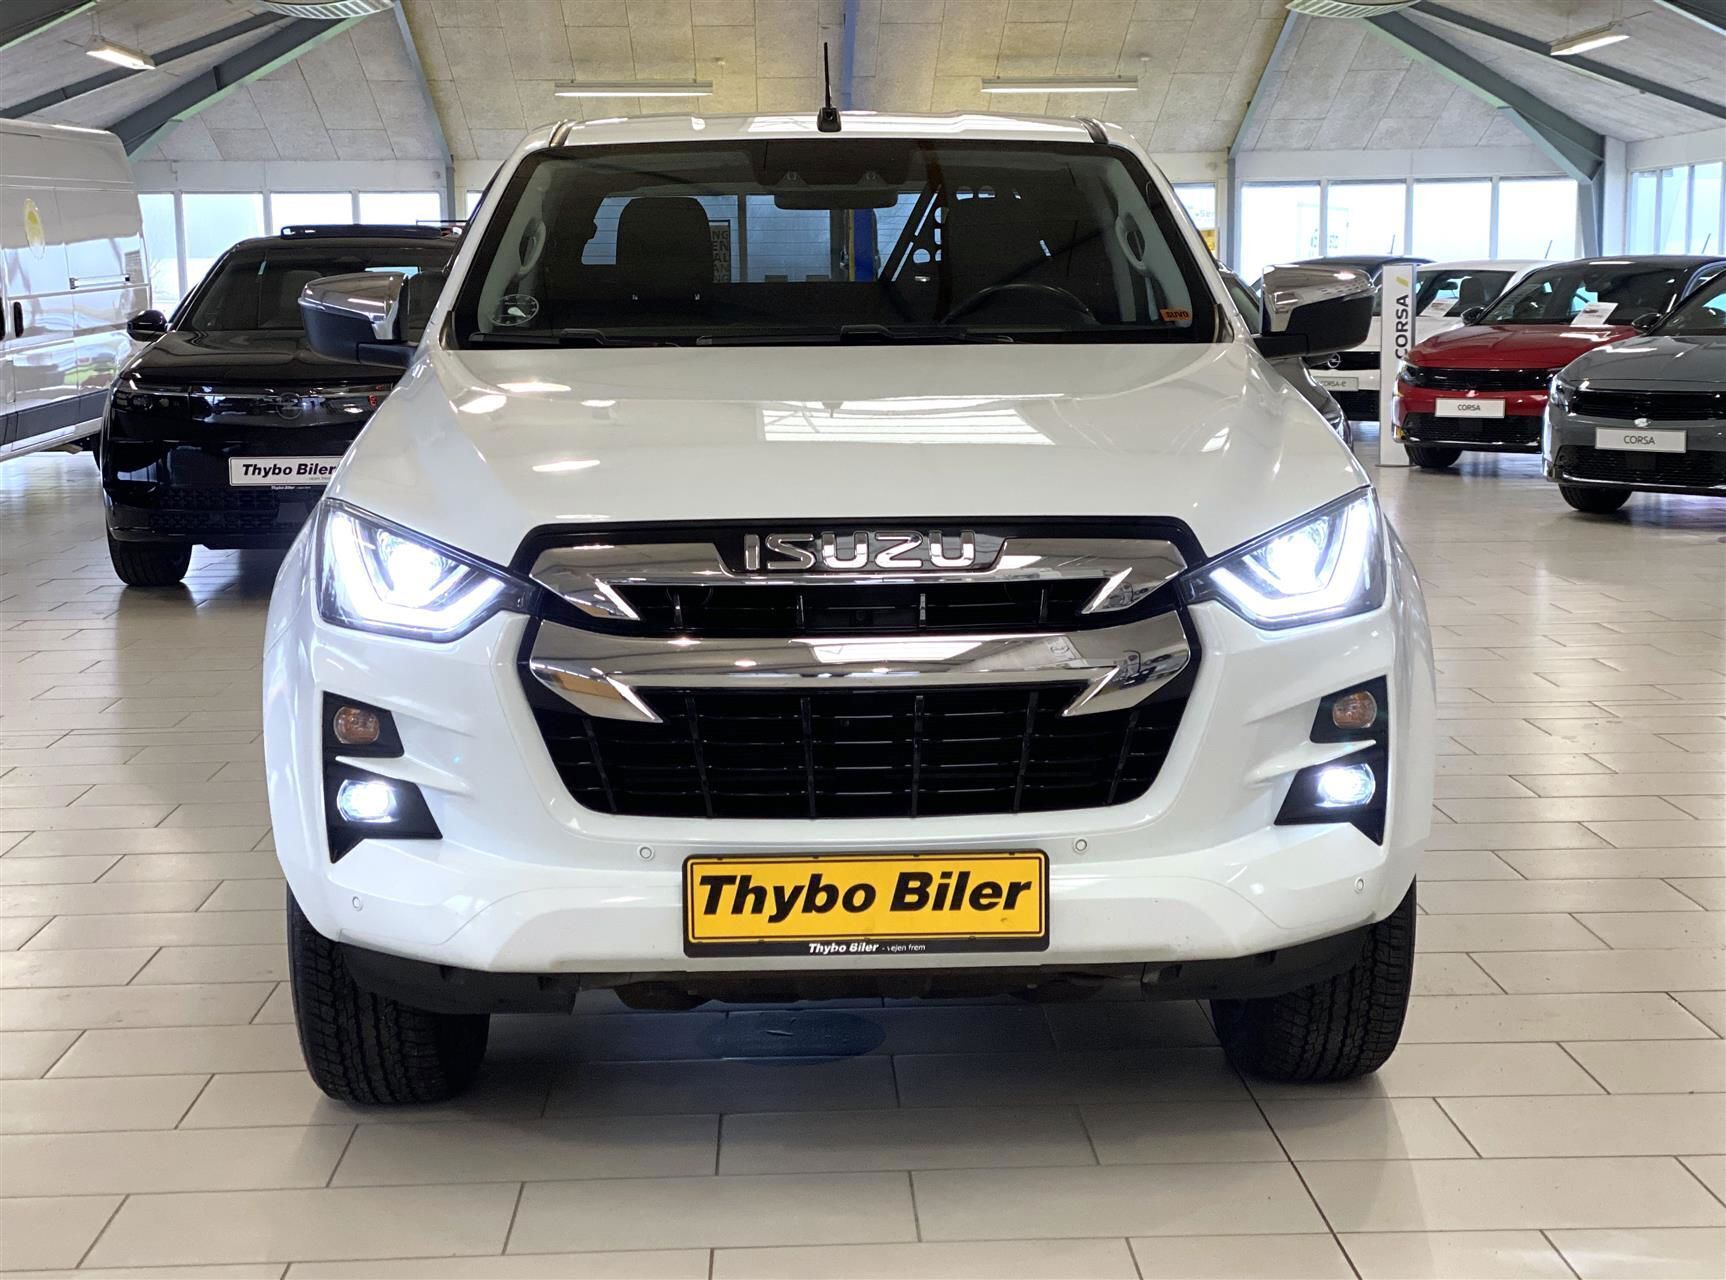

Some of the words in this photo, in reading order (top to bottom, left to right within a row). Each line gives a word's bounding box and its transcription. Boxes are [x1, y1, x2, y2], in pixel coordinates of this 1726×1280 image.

[1395, 294, 1409, 360] CORSA
[1457, 403, 1481, 412] CORSA
[1623, 435, 1655, 446] CORSA
[242, 463, 293, 478] Thybo
[296, 463, 336, 475] Biler
[744, 530, 976, 571] ISUZU
[699, 873, 877, 923] Thybo
[889, 870, 1032, 912] Biler
[808, 942, 847, 954] Thybo
[849, 942, 879, 952] Biler
[908, 943, 926, 951] frem
